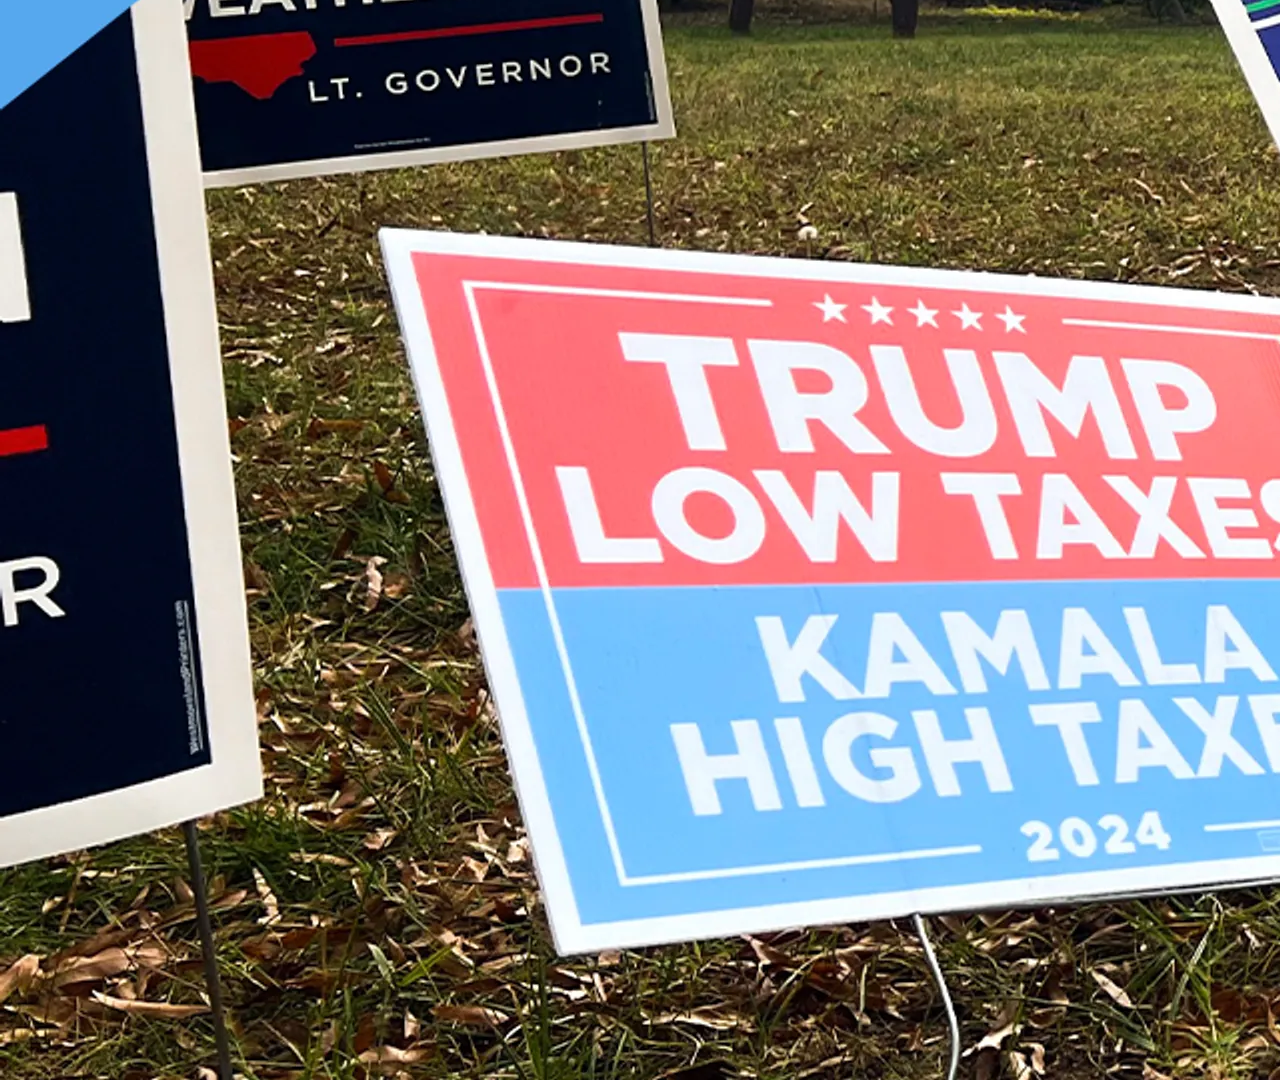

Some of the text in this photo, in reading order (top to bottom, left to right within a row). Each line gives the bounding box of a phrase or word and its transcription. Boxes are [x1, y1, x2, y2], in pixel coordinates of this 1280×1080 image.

[309, 78, 363, 102] LT.
[385, 52, 612, 95] GOVERNOR
[617, 332, 1217, 461] TRUMP
[555, 465, 900, 565] LOW
[754, 604, 1278, 704] KAMALA
[669, 705, 1014, 817] HIGH
[1020, 809, 1172, 863] 2024
